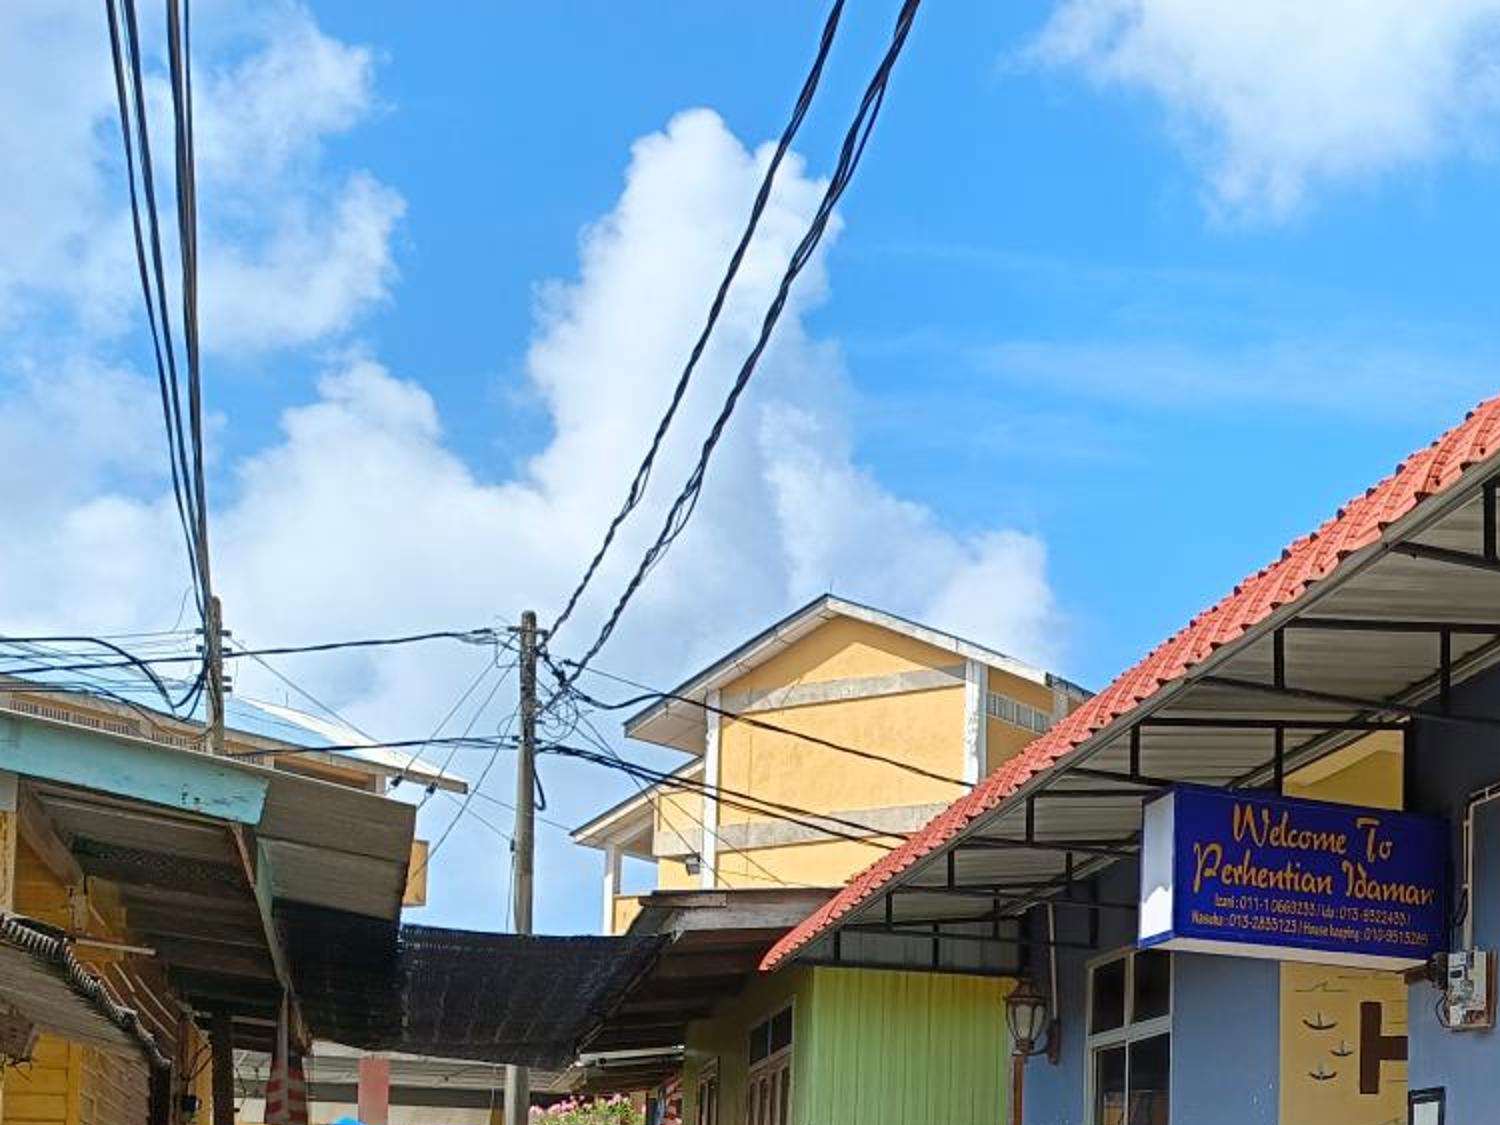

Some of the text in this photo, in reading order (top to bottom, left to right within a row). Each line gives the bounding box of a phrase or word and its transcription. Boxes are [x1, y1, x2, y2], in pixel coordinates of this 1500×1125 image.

[1231, 802, 1393, 862] Welcome To
[1192, 842, 1434, 905] Perhentian Idaman
